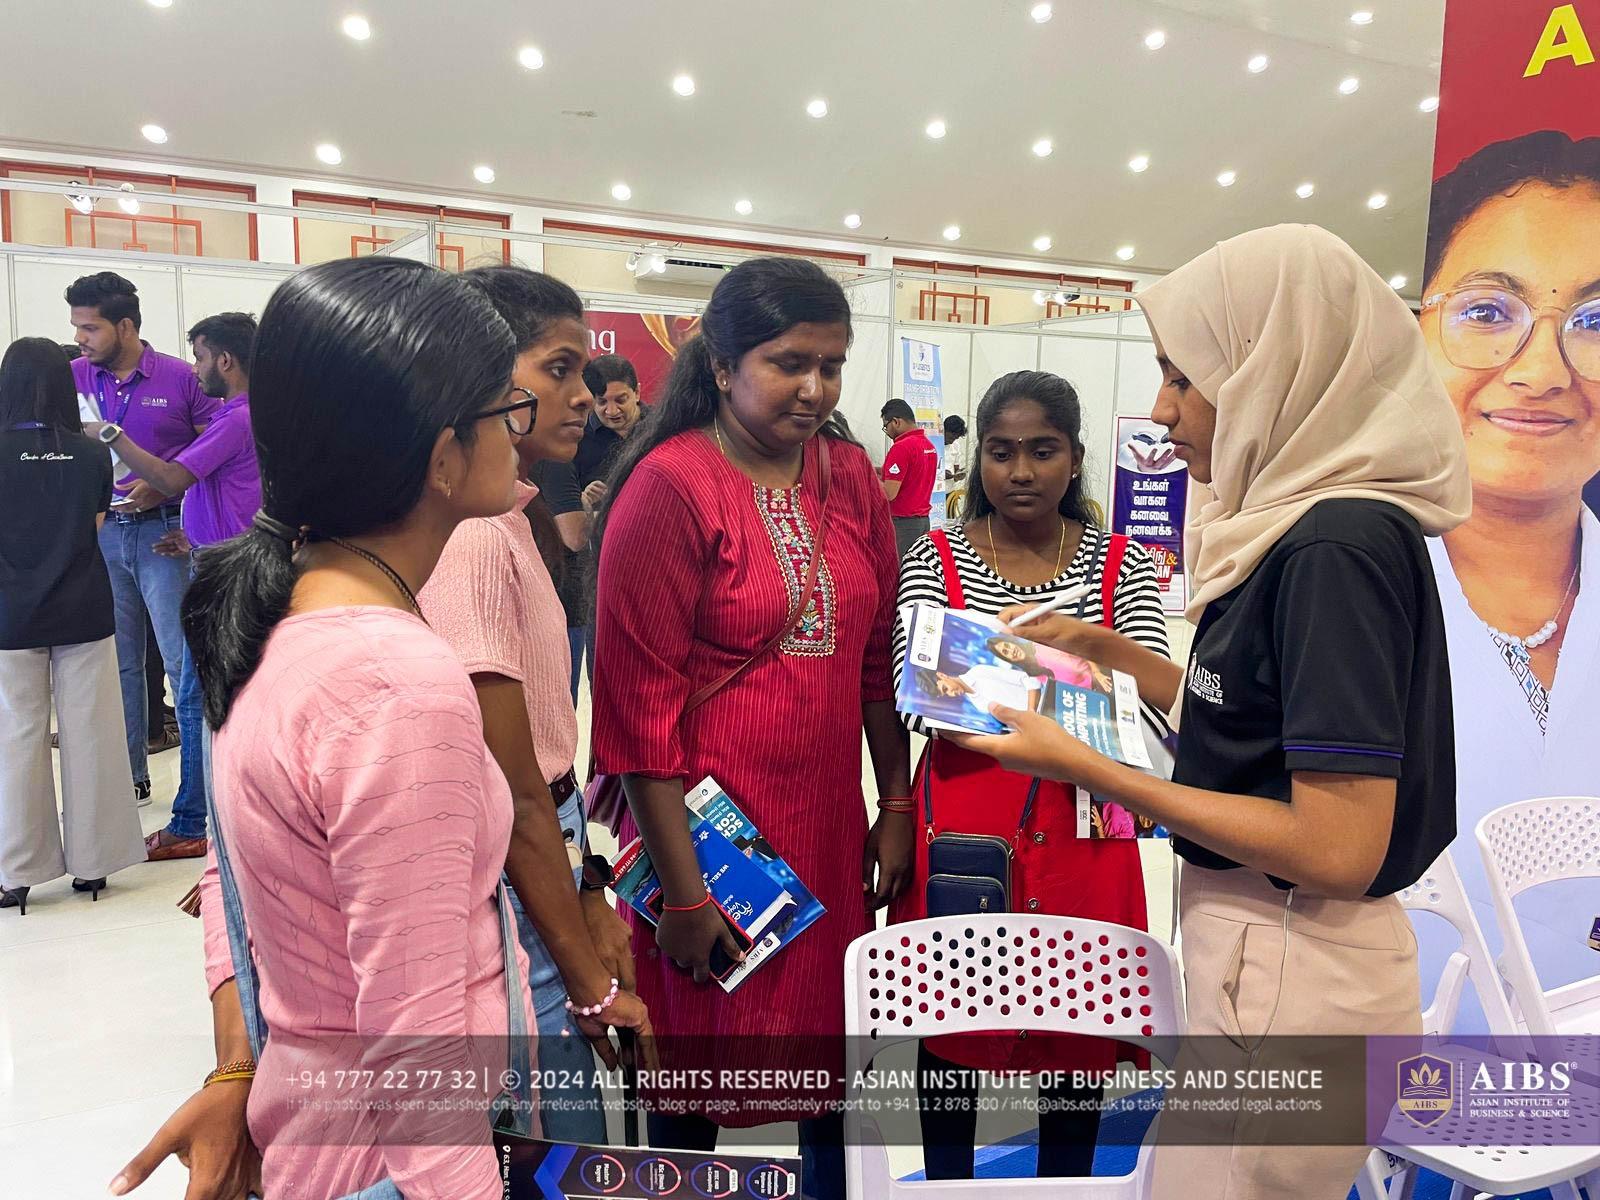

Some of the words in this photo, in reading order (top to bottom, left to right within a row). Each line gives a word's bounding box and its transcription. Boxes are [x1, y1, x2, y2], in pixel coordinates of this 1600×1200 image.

[1132, 478, 1170, 492] உங்கள்
[1133, 495, 1168, 506] வாகன
[1130, 510, 1169, 521] கனவை
[1194, 664, 1221, 690] AIBS
[1062, 690, 1075, 708] OF
[503, 1166, 511, 1180] Hon.
[594, 1164, 602, 1183] Degree
[603, 1163, 611, 1185] Master's
